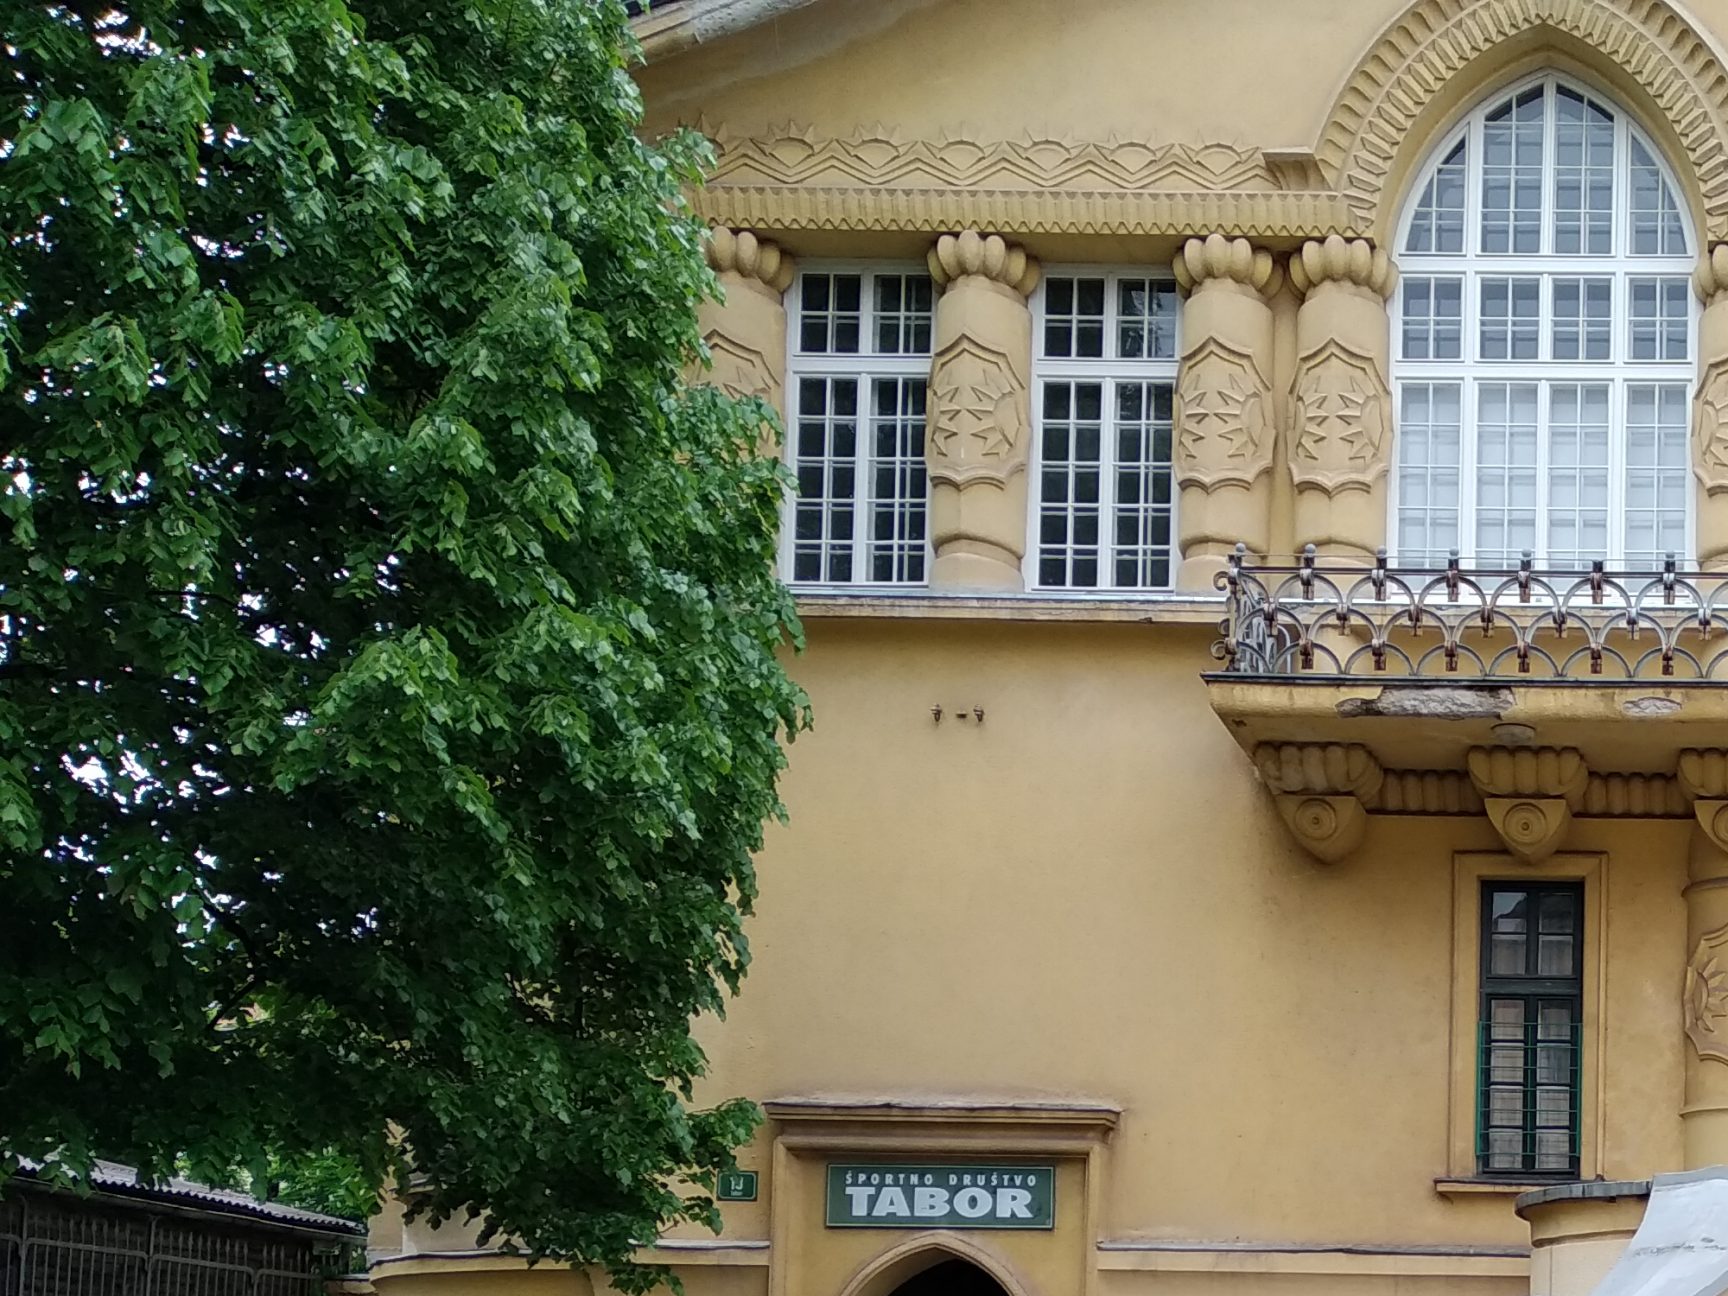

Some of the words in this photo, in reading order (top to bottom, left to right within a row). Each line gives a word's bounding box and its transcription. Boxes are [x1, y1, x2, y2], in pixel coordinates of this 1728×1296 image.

[845, 1170, 934, 1186] ŠPORTNO
[949, 1171, 1037, 1187] DRUŠTVO
[845, 1186, 1034, 1218] TABOR
